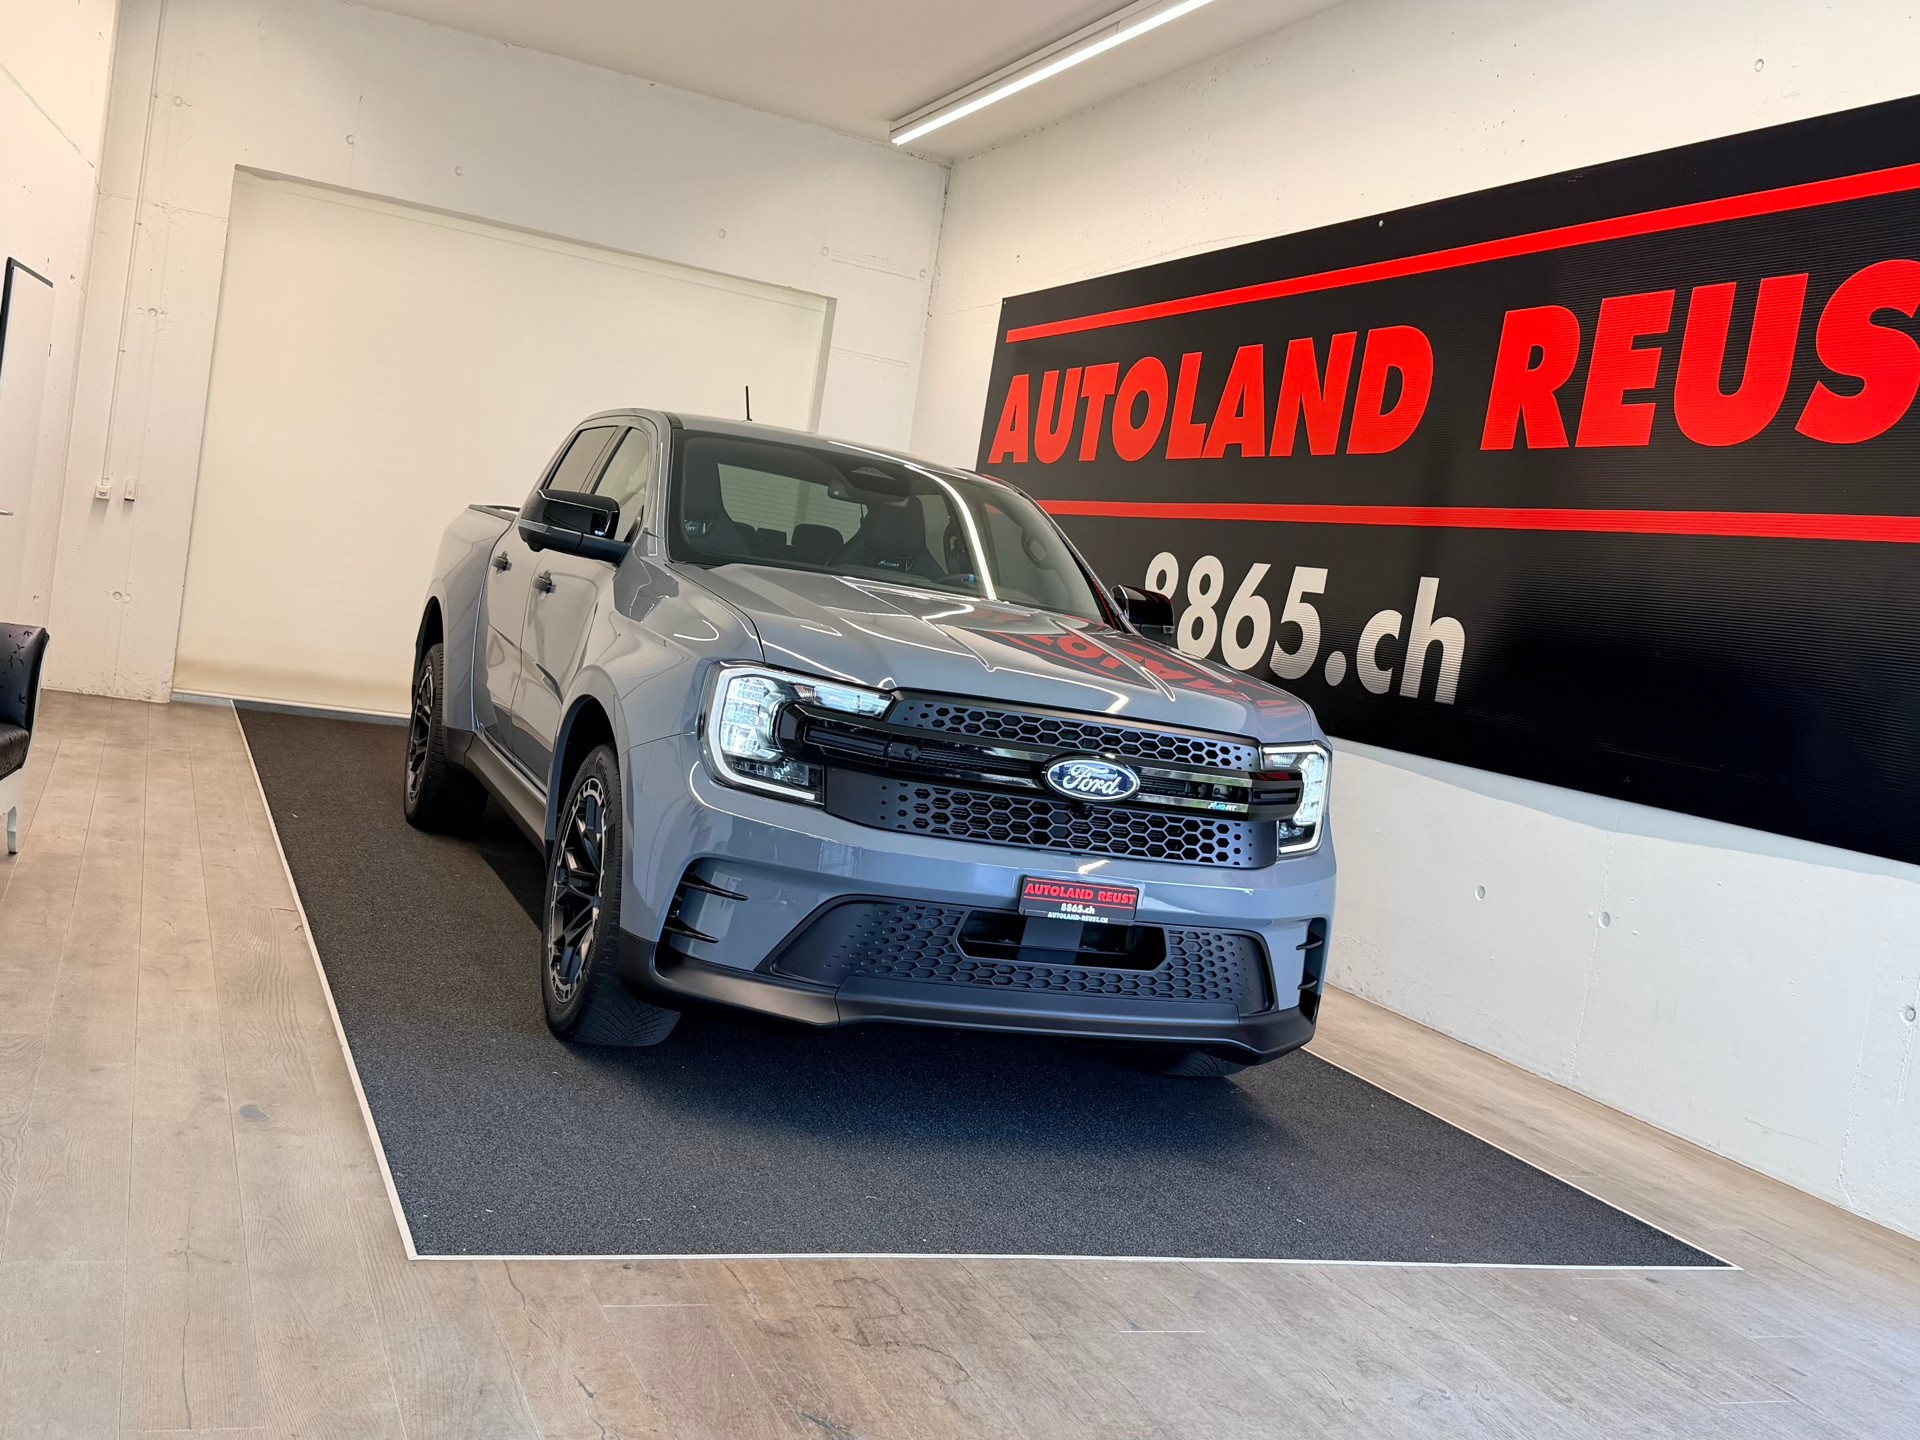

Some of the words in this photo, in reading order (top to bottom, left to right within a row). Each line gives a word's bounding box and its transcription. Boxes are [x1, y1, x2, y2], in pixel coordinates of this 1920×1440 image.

[987, 324, 1434, 464] AUTOLAND
[1480, 259, 1920, 451] REUS
[1062, 764, 1122, 795] Ford
[1024, 883, 1094, 901] AUTOLAND
[1097, 890, 1137, 905] REUST
[1047, 911, 1109, 924] AUTOLAND-REUST.CH
[1060, 902, 1096, 915] 8865.ch
